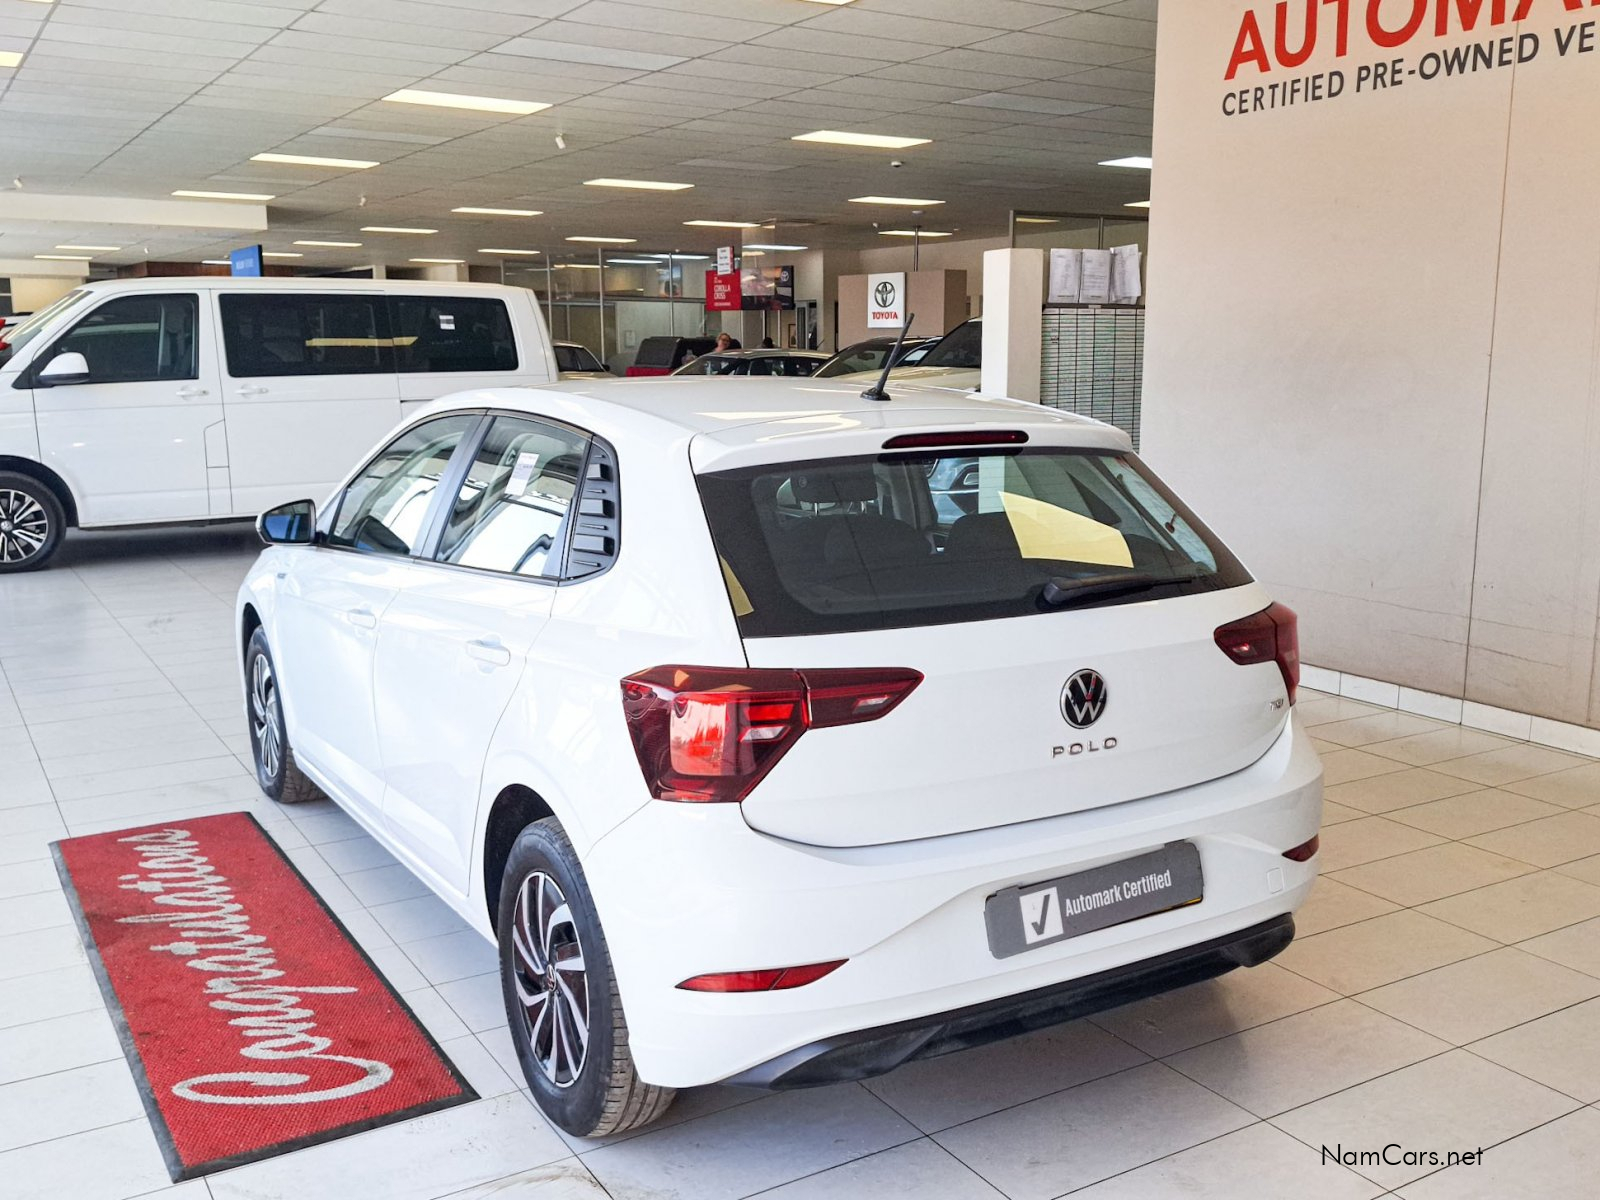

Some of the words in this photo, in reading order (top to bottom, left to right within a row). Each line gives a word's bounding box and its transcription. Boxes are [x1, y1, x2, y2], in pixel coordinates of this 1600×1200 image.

[1224, 0, 1600, 80] AUTO
[1221, 70, 1344, 116] CERTIFIED
[1355, 32, 1539, 93] PRE-OWNED
[872, 311, 898, 320] TOYOTA
[1052, 736, 1118, 758] POLO
[1065, 885, 1122, 917] Automark
[1122, 869, 1172, 900] Certified
